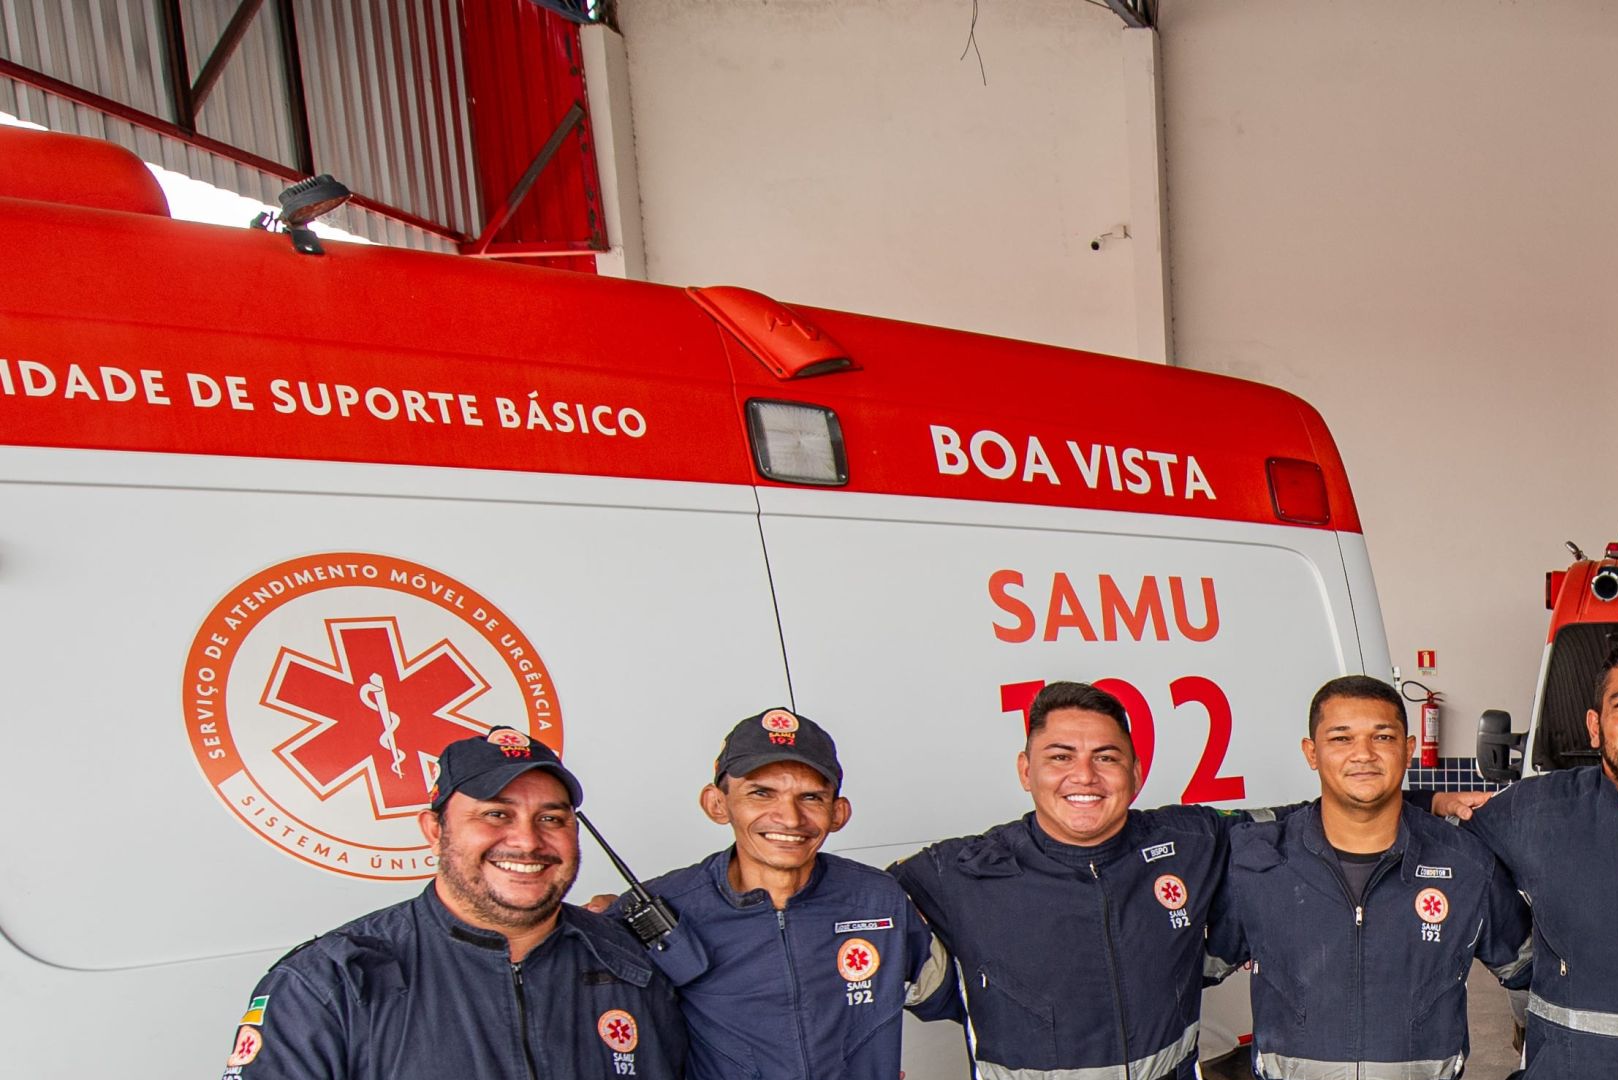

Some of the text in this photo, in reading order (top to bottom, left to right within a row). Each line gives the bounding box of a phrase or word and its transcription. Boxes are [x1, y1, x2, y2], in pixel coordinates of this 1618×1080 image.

[186, 373, 254, 411] DE
[270, 379, 484, 427] SUPORTE
[496, 391, 647, 438] BÁSICO
[930, 425, 1217, 500] BOA VISTA
[988, 569, 1220, 643] SAMU
[196, 564, 552, 759] SERVIÇO DE ATENDIMENTO MÓVEL DE URGÊNCIA
[241, 796, 440, 870] SISTEMA ÚNIC
[1170, 917, 1191, 929] 192
[1421, 923, 1441, 931] SAMU
[1421, 931, 1440, 942] 192
[847, 980, 872, 991] SAMU
[846, 990, 873, 1006] 192
[613, 1052, 635, 1062] SAMU
[614, 1062, 636, 1075] 192
